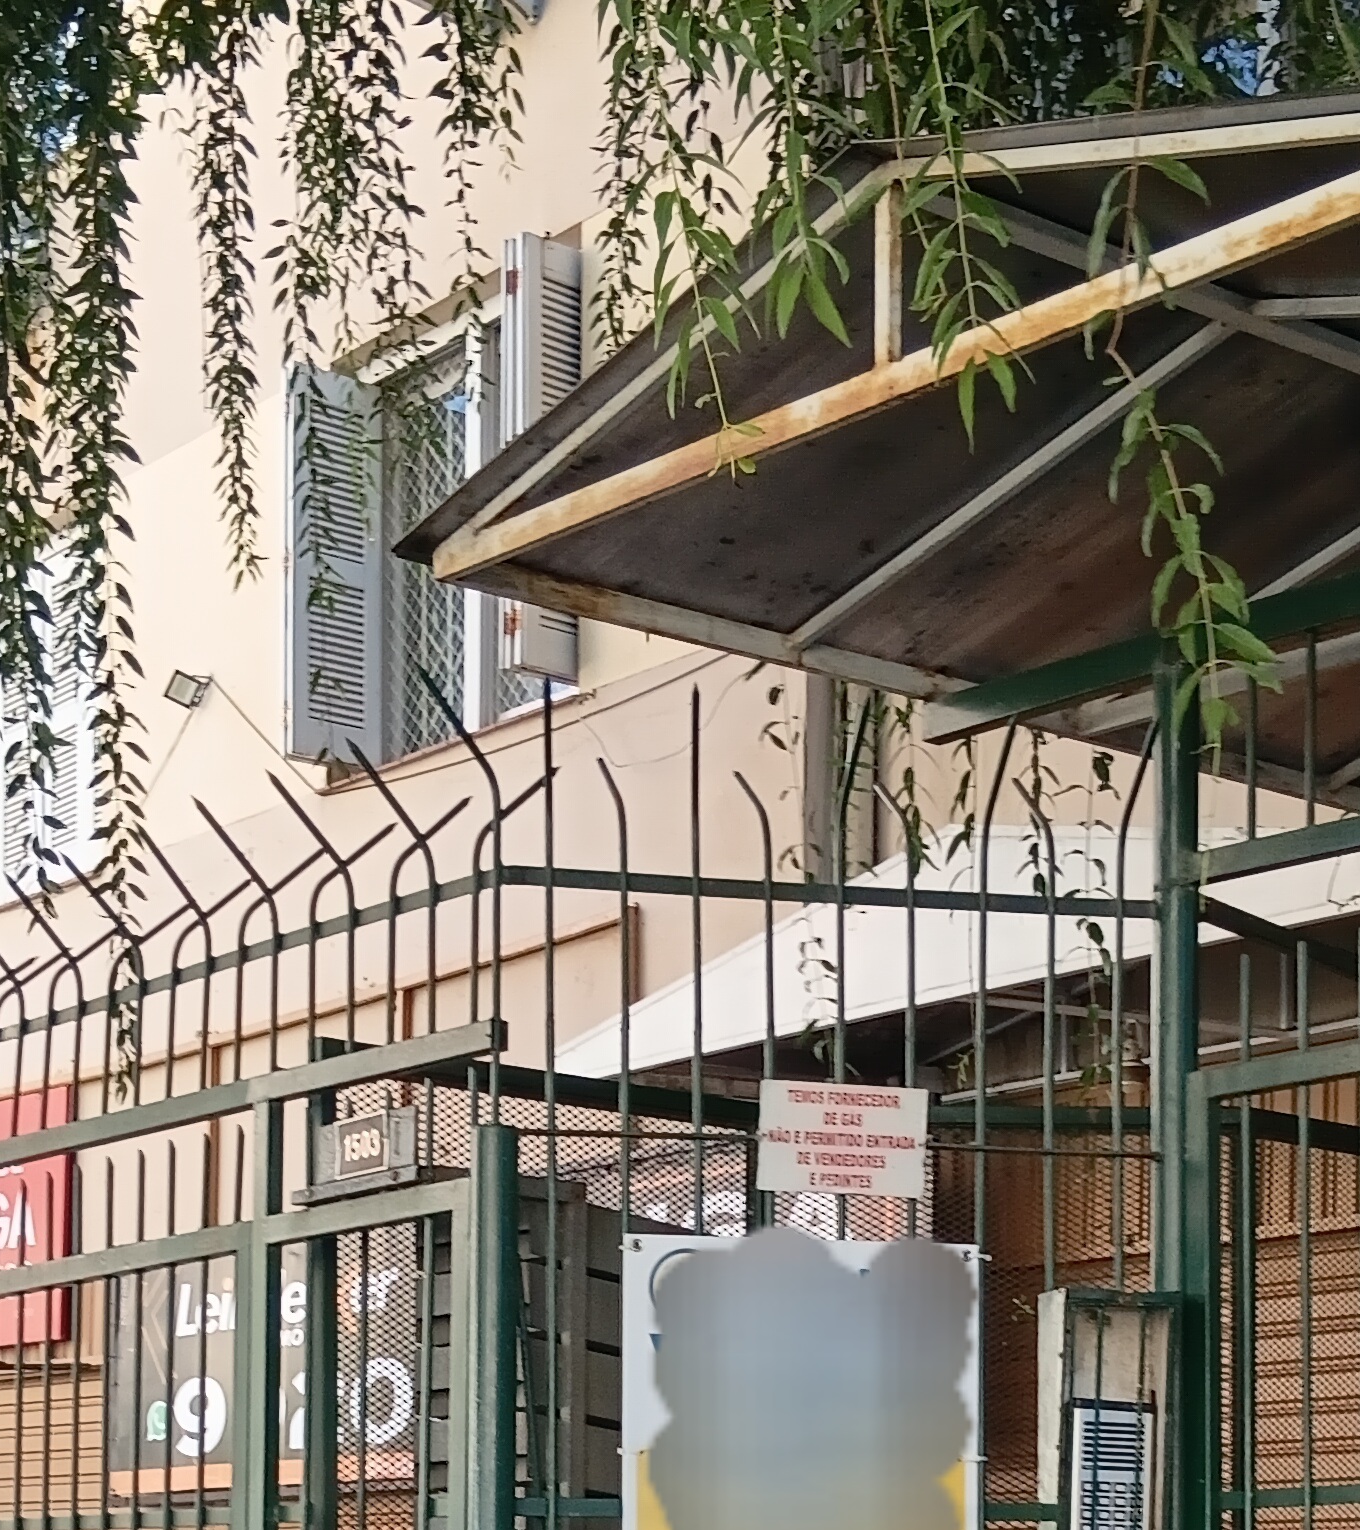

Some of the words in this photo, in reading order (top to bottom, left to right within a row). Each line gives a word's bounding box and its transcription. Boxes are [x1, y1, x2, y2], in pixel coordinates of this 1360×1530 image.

[787, 1089, 825, 1105] TEMOS
[827, 1091, 901, 1110] FORNECEDOR
[823, 1111, 839, 1126] DE
[343, 1127, 381, 1162] 1503
[768, 1126, 791, 1144] NÃO
[804, 1131, 864, 1148] PERMITIDO
[866, 1133, 916, 1150] ENTRADA
[796, 1151, 811, 1166] DE
[814, 1152, 887, 1169] VENDEDORES
[809, 1171, 817, 1186] E
[820, 1172, 873, 1189] PEDINTES
